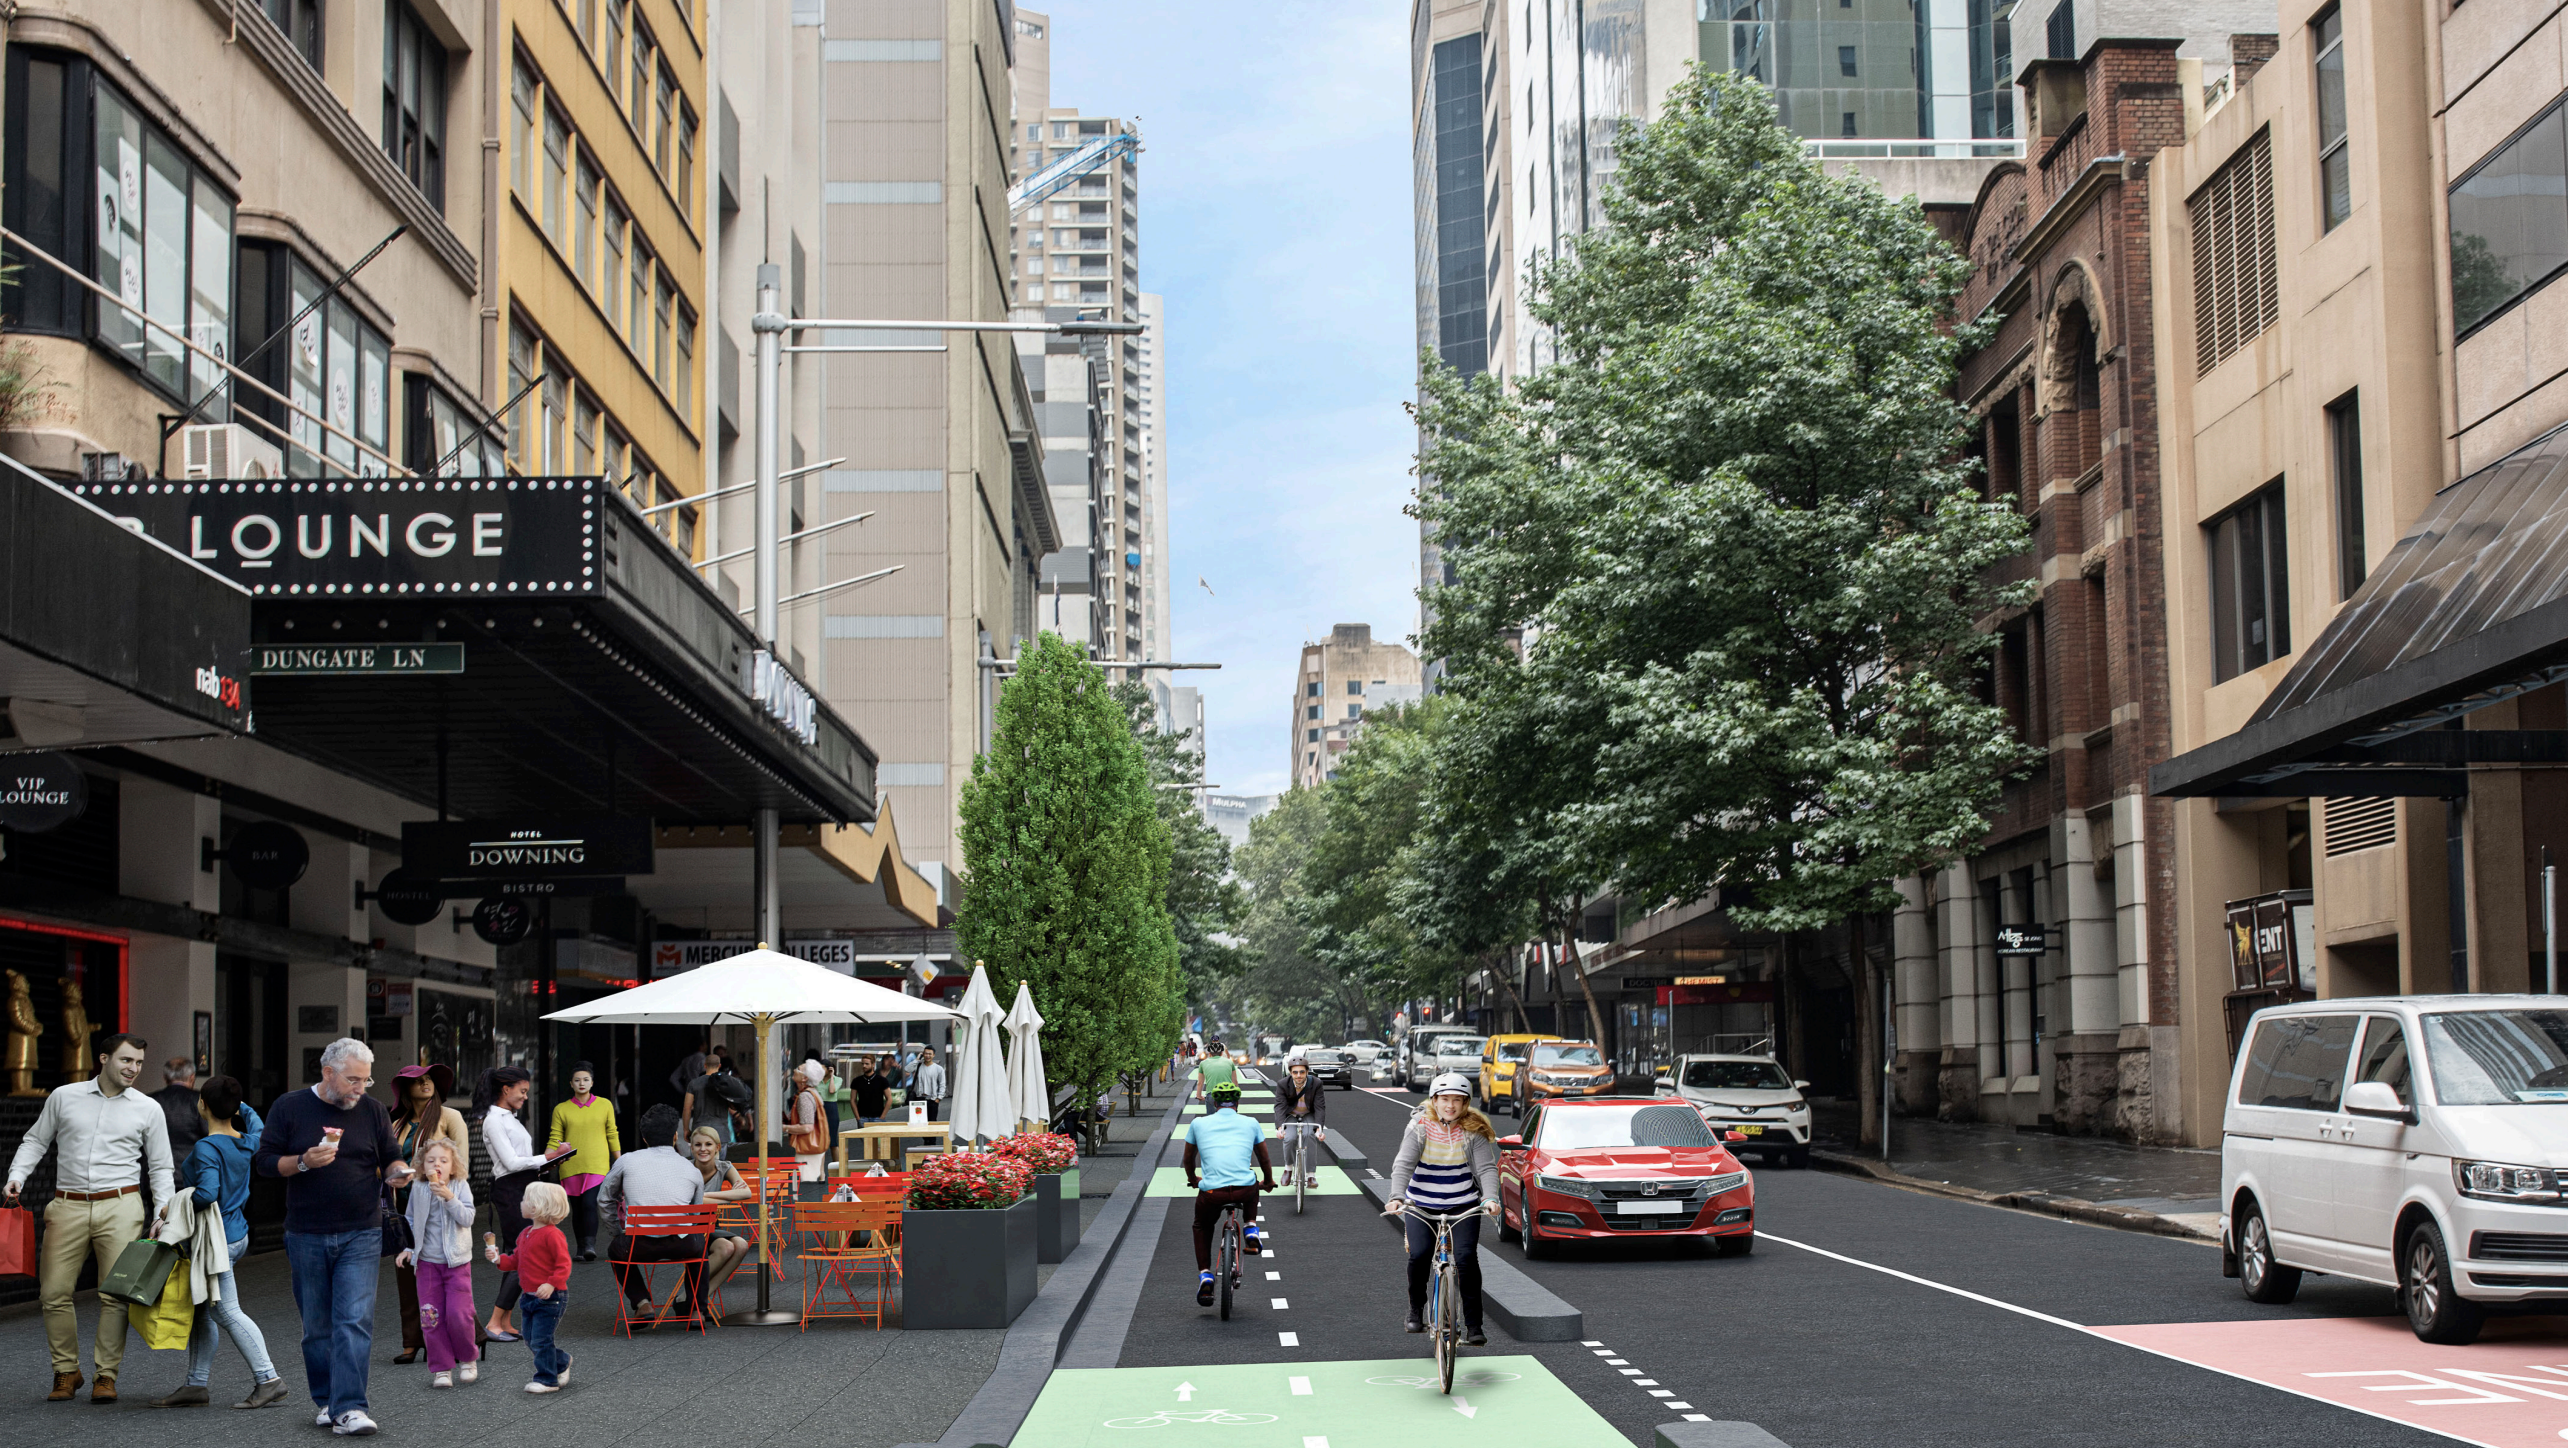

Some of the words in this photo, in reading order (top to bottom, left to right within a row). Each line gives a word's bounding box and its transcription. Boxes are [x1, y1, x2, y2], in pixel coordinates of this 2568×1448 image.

[191, 514, 503, 567] LOUNGE
[262, 649, 375, 669] DUNGATE
[392, 648, 426, 668] LN
[17, 777, 45, 790] VIP
[252, 850, 279, 860] BAR
[469, 847, 585, 866] DOWNING
[503, 884, 554, 893] BISTRO
[386, 891, 431, 900] HOSTEL
[1629, 979, 1667, 987] DOCTOR
